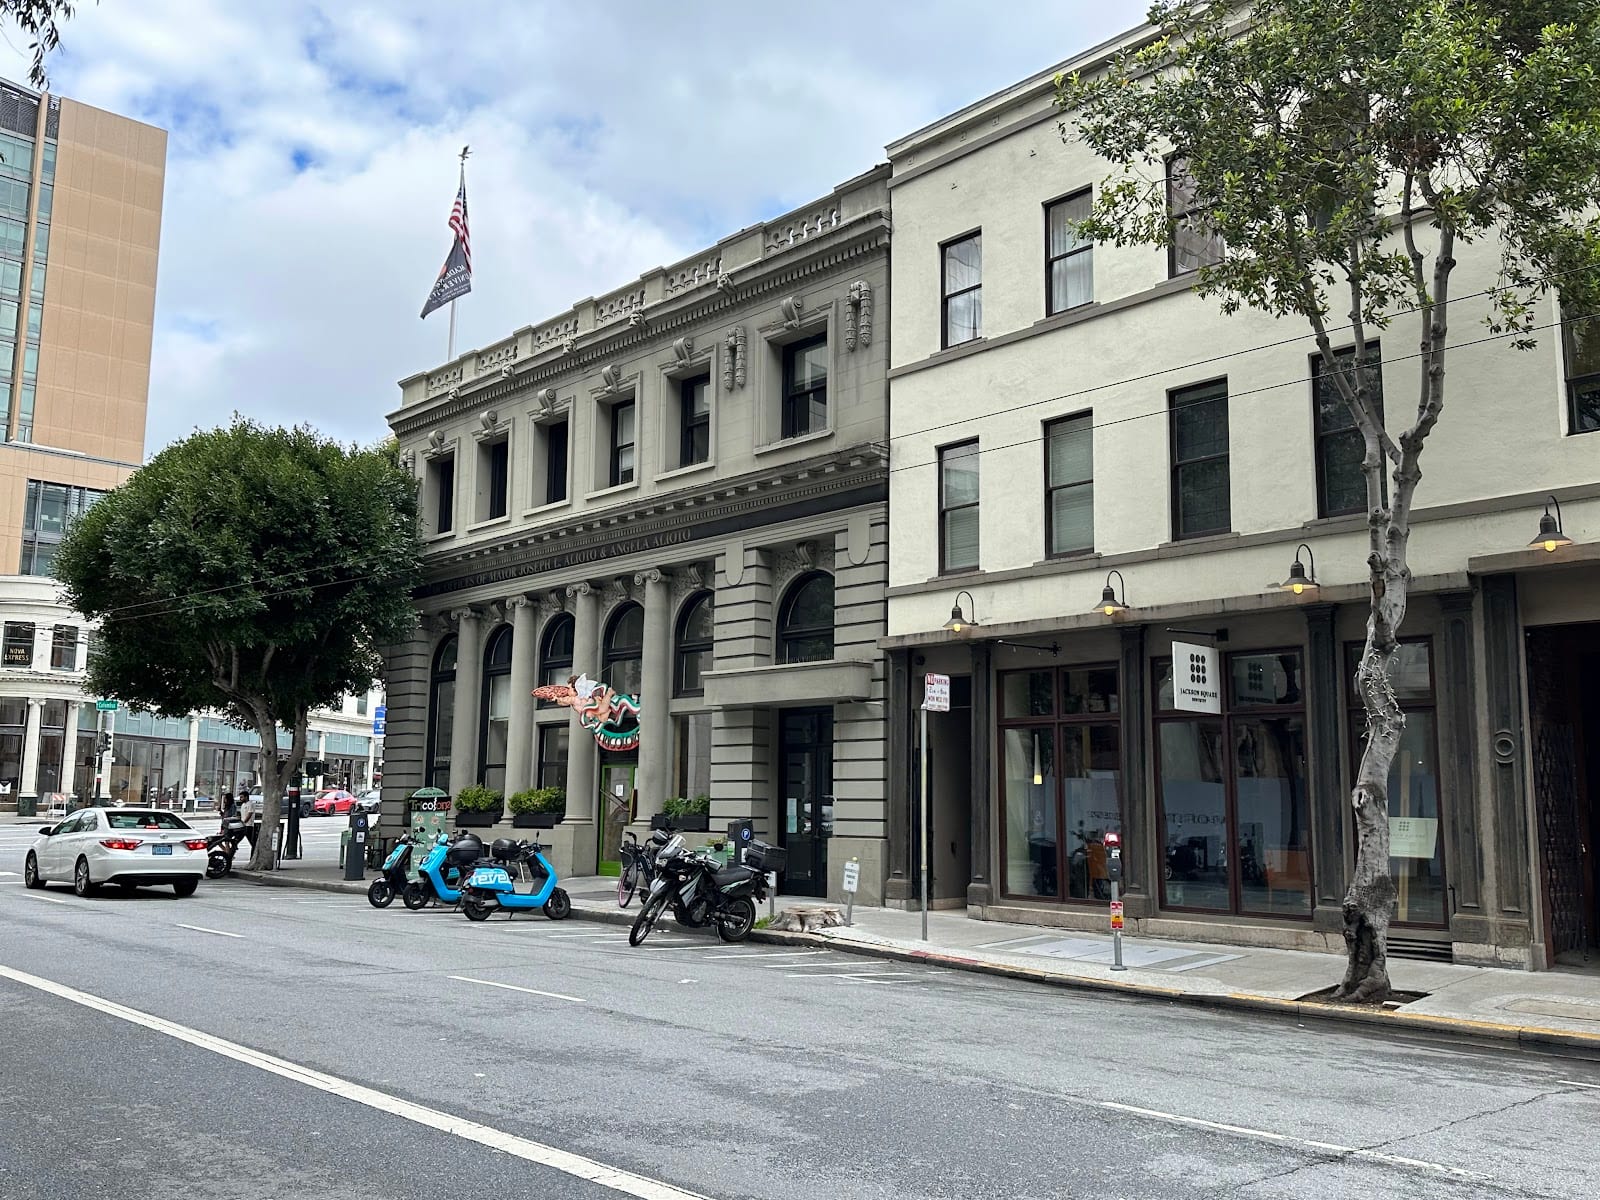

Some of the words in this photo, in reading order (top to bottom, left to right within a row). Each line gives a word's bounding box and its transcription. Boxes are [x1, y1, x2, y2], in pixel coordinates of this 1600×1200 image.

[488, 566, 517, 582] MAYOR
[519, 559, 551, 575] JOSEPH
[565, 548, 597, 565] ALIOTO
[600, 547, 607, 558] &
[610, 538, 649, 555] ANGELA
[653, 528, 691, 546] ALIOTO
[5, 653, 29, 661] EXPRESS
[1180, 688, 1200, 696] JACKSON
[1200, 690, 1218, 699] SQUARE
[98, 701, 116, 709] Columbus
